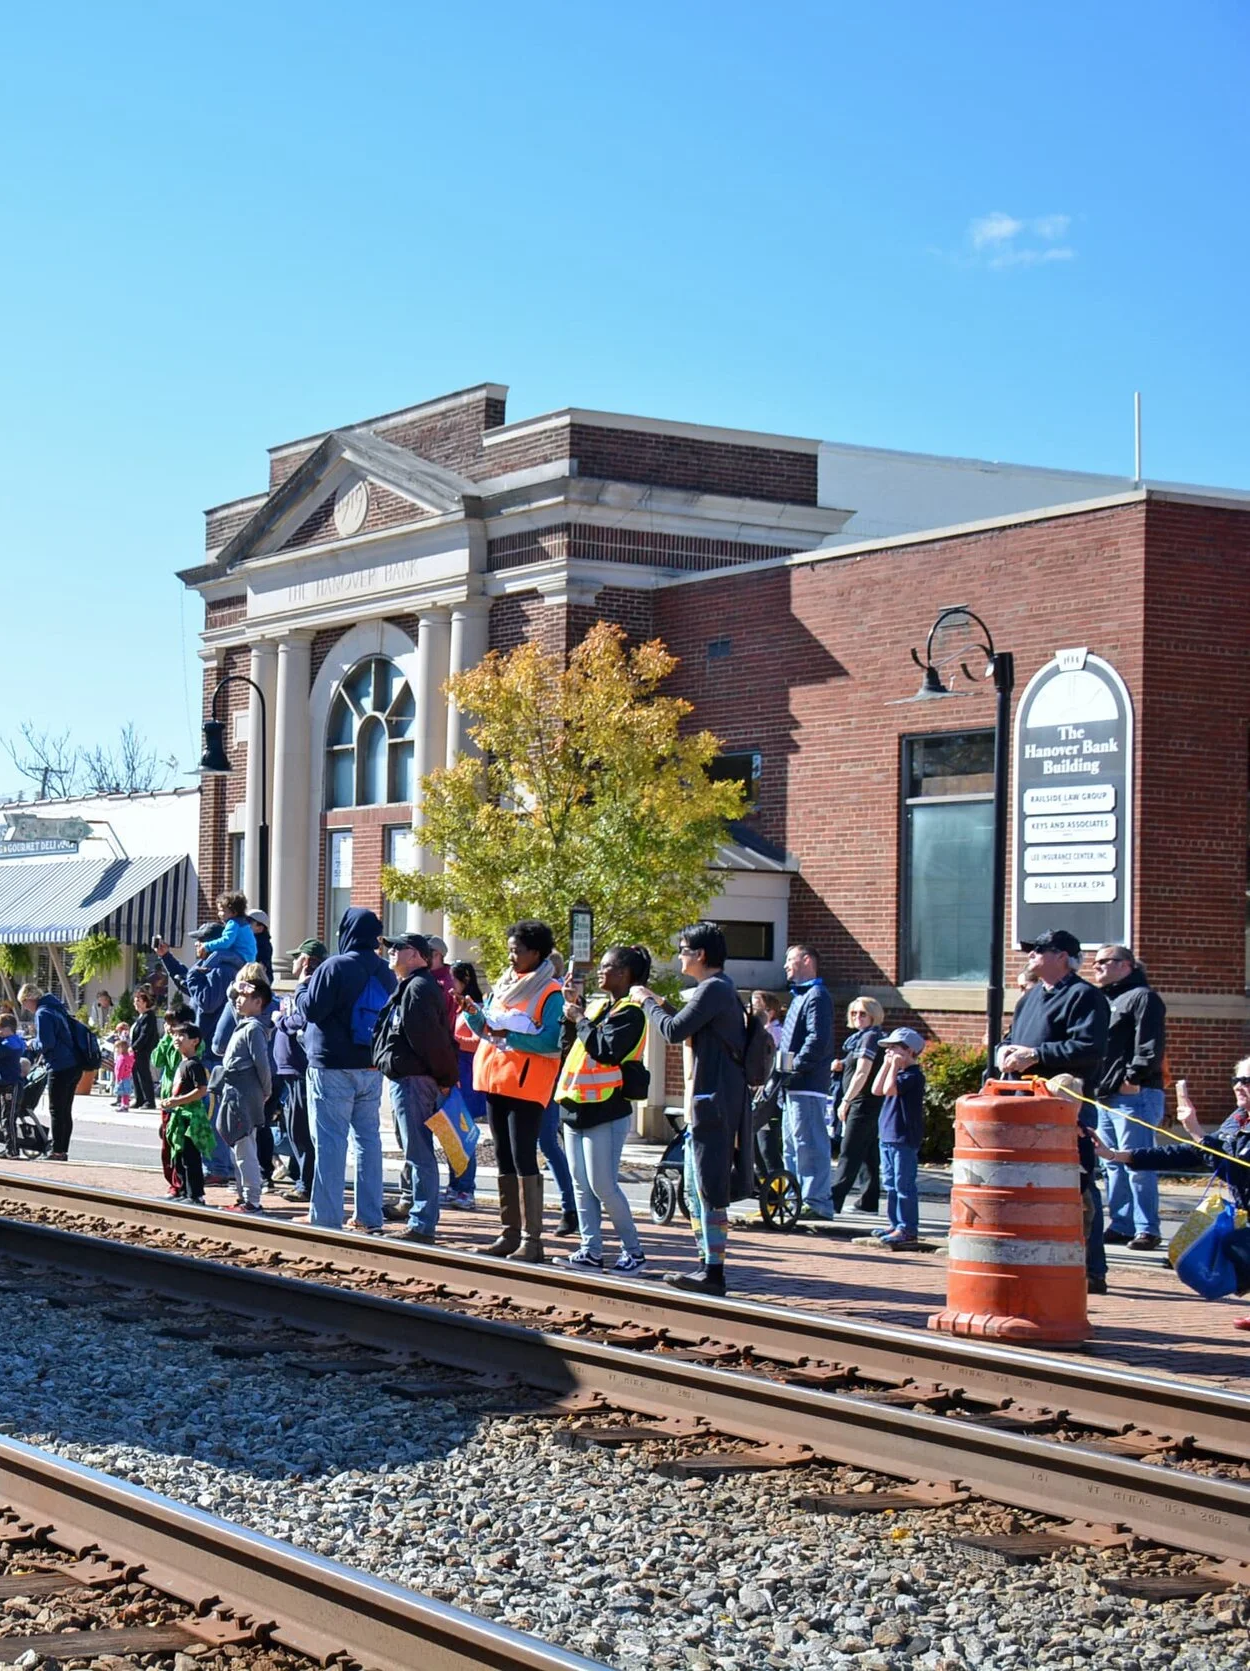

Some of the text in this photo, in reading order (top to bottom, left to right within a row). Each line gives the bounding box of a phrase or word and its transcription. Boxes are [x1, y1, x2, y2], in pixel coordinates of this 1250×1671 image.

[316, 568, 376, 597] HANOVER
[384, 559, 418, 582] BANK
[1057, 725, 1085, 740] The
[1024, 737, 1118, 759] Hanover Bank
[1042, 759, 1100, 775] Building
[1030, 791, 1107, 803] RAILSIDE LAW GROUP
[1031, 820, 1109, 830] KEYS AND ASSOCIATES
[7, 841, 40, 853] GOURMET
[40, 840, 56, 850] DELI
[1091, 880, 1105, 888] CPA
